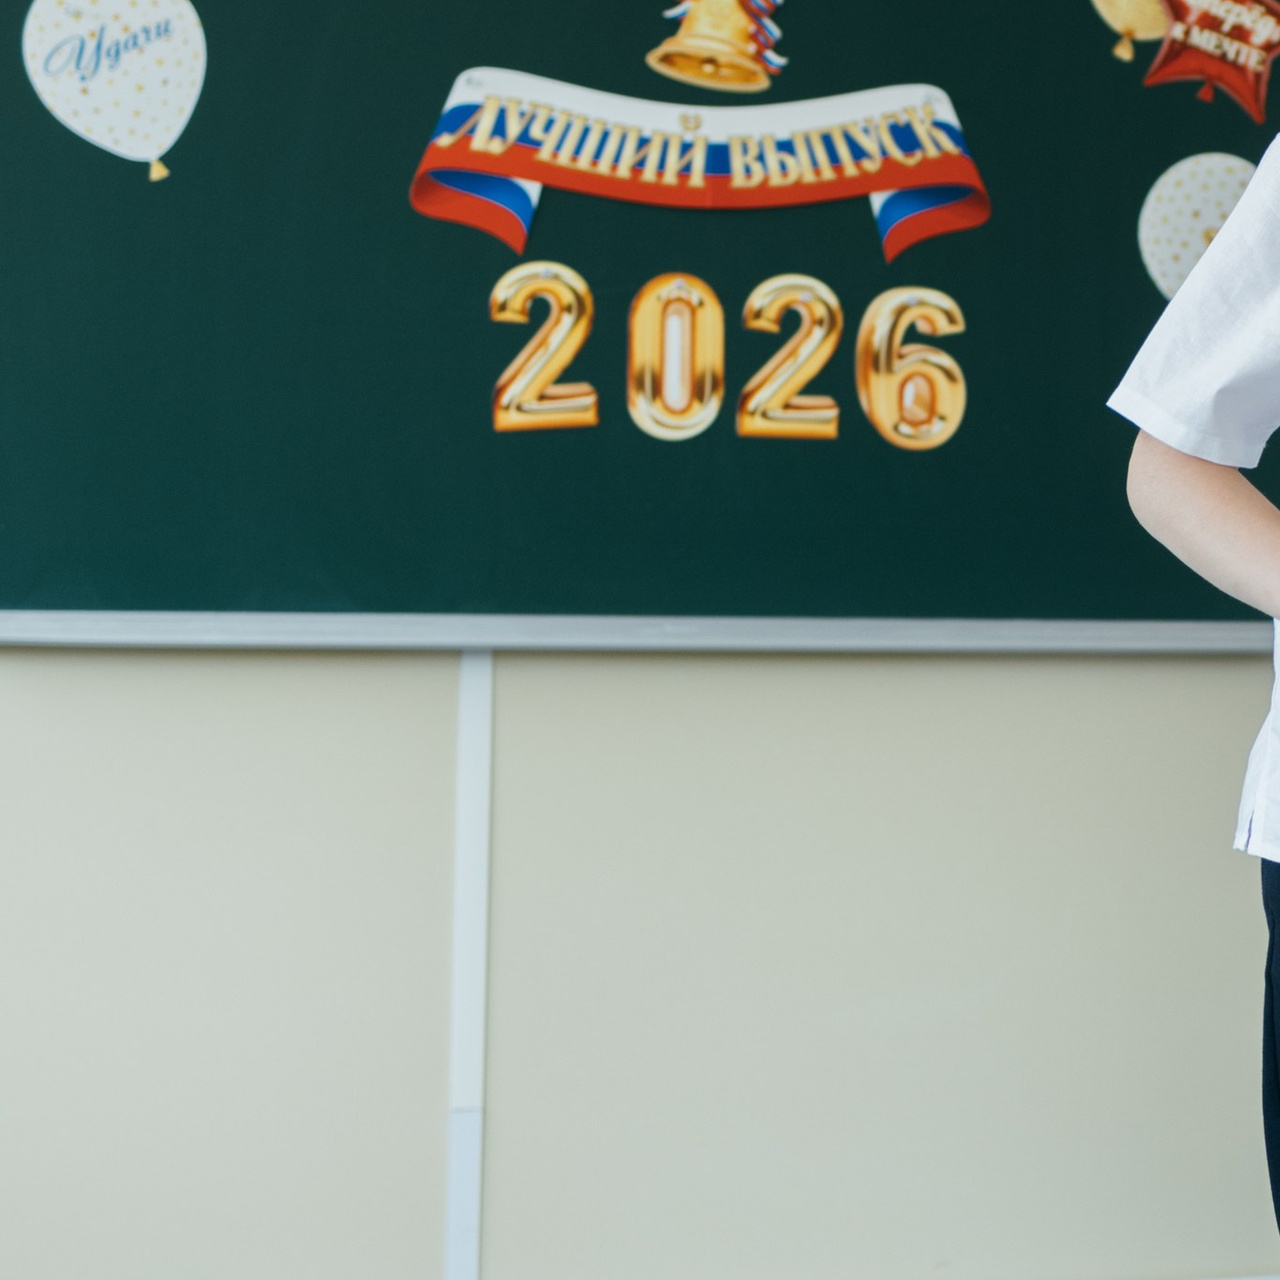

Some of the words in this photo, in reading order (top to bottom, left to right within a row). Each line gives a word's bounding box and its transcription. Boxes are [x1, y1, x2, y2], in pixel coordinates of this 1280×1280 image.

[43, 19, 171, 83] Удачи
[1187, 24, 1267, 73] МЕЧТЕ
[436, 94, 707, 188] ЛУЧШИЙ
[730, 102, 963, 188] ВЫПУСК
[489, 261, 967, 451] 2026
